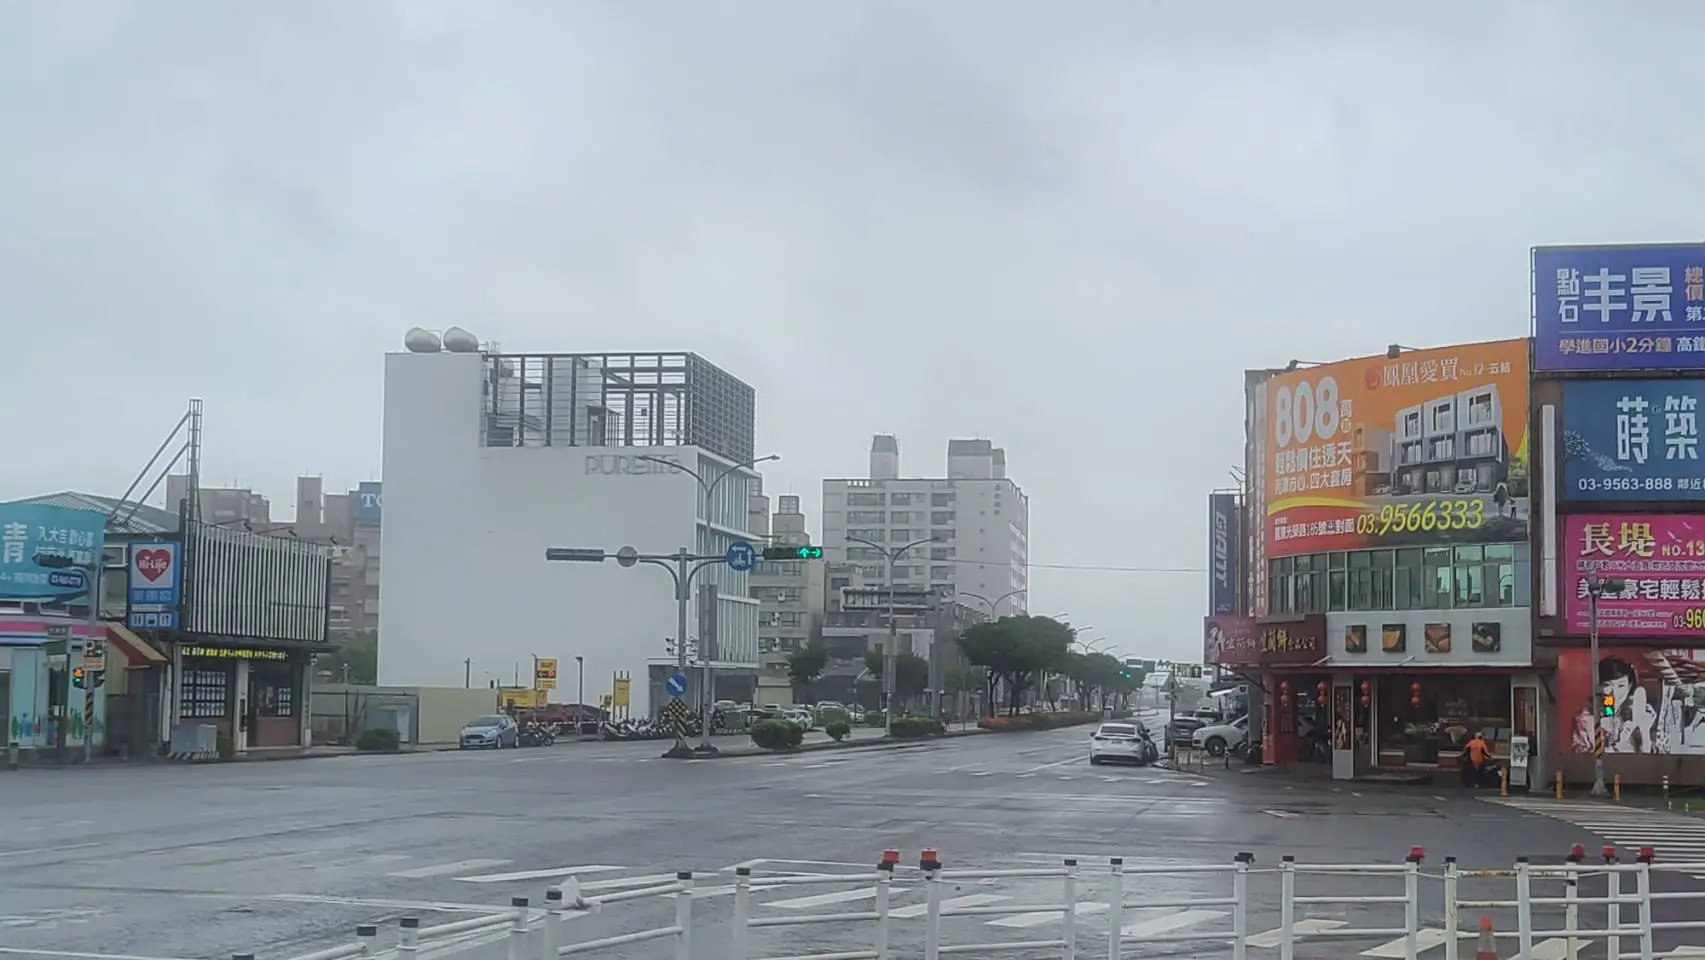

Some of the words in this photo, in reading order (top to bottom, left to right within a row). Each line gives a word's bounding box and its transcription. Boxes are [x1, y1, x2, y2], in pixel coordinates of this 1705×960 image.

[1556, 267, 1580, 323] 點石
[1582, 267, 1673, 323] 丰景
[1559, 337, 1672, 355] 學進國小2分鐘
[1274, 375, 1340, 448] 808
[1578, 478, 1673, 491] 03-9563-888
[1677, 478, 1705, 491] 鄰近
[2, 521, 28, 564] 青
[1579, 522, 1656, 558] 長堤
